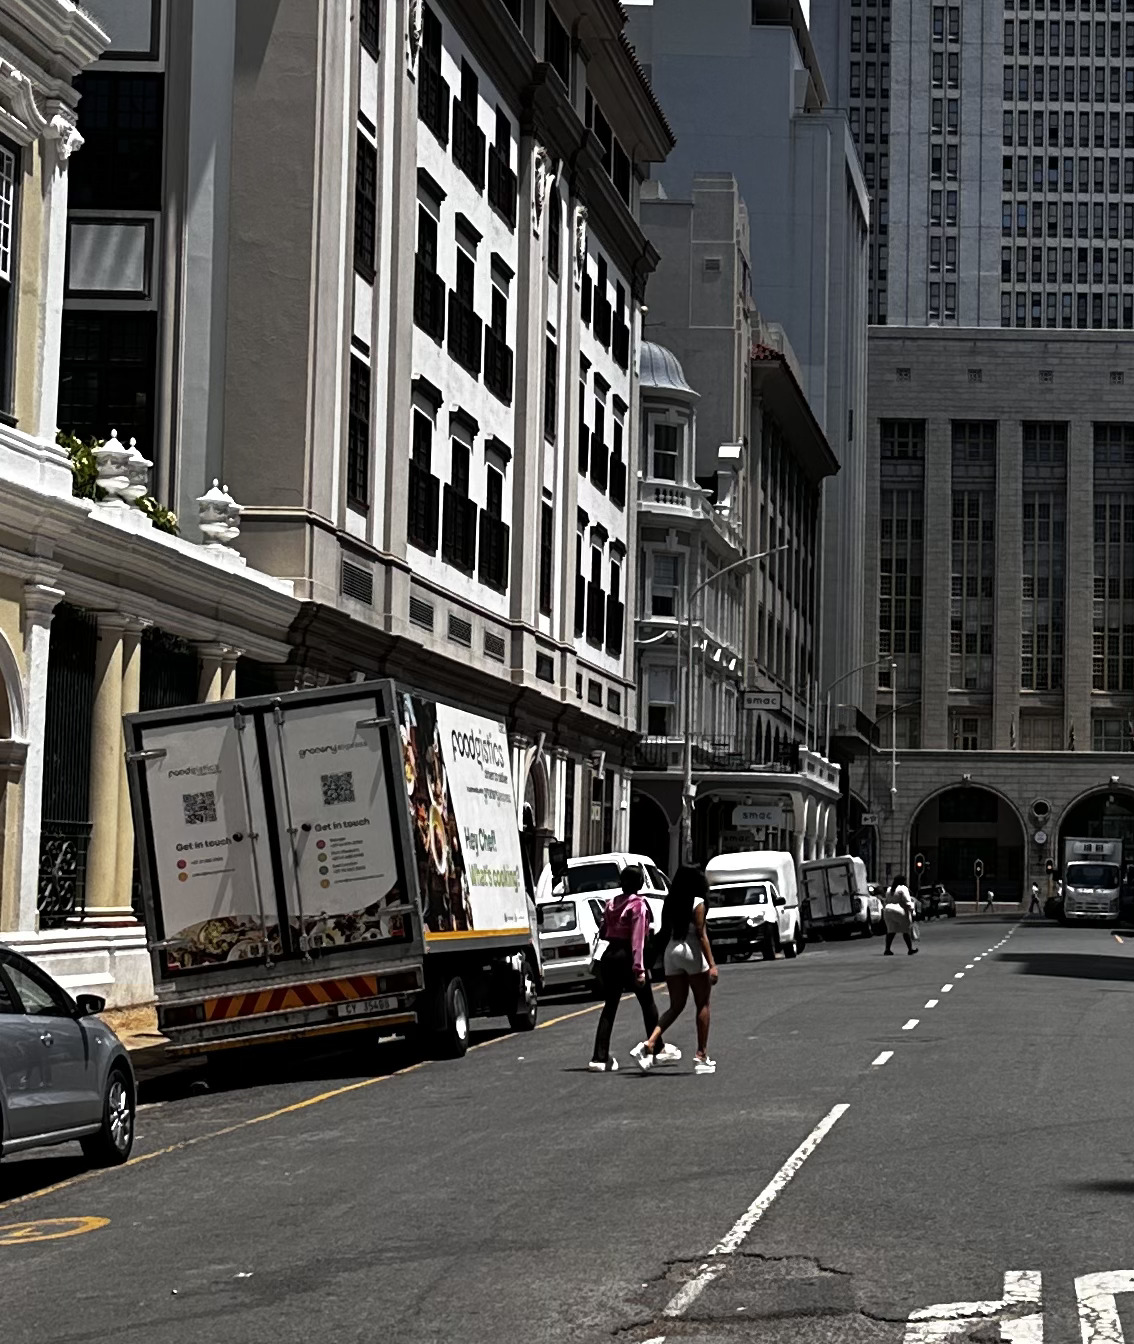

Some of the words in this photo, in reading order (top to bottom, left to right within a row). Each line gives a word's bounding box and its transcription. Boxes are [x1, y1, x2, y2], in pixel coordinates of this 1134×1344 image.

[746, 696, 776, 705] smac
[452, 729, 504, 770] foodgistics
[742, 811, 772, 820] smac
[315, 823, 332, 832] Get
[344, 818, 370, 828] touch
[176, 842, 193, 851] Get
[195, 841, 203, 849] in
[205, 837, 232, 847] touch
[464, 826, 479, 857] Hey
[346, 1004, 356, 1014] CY
